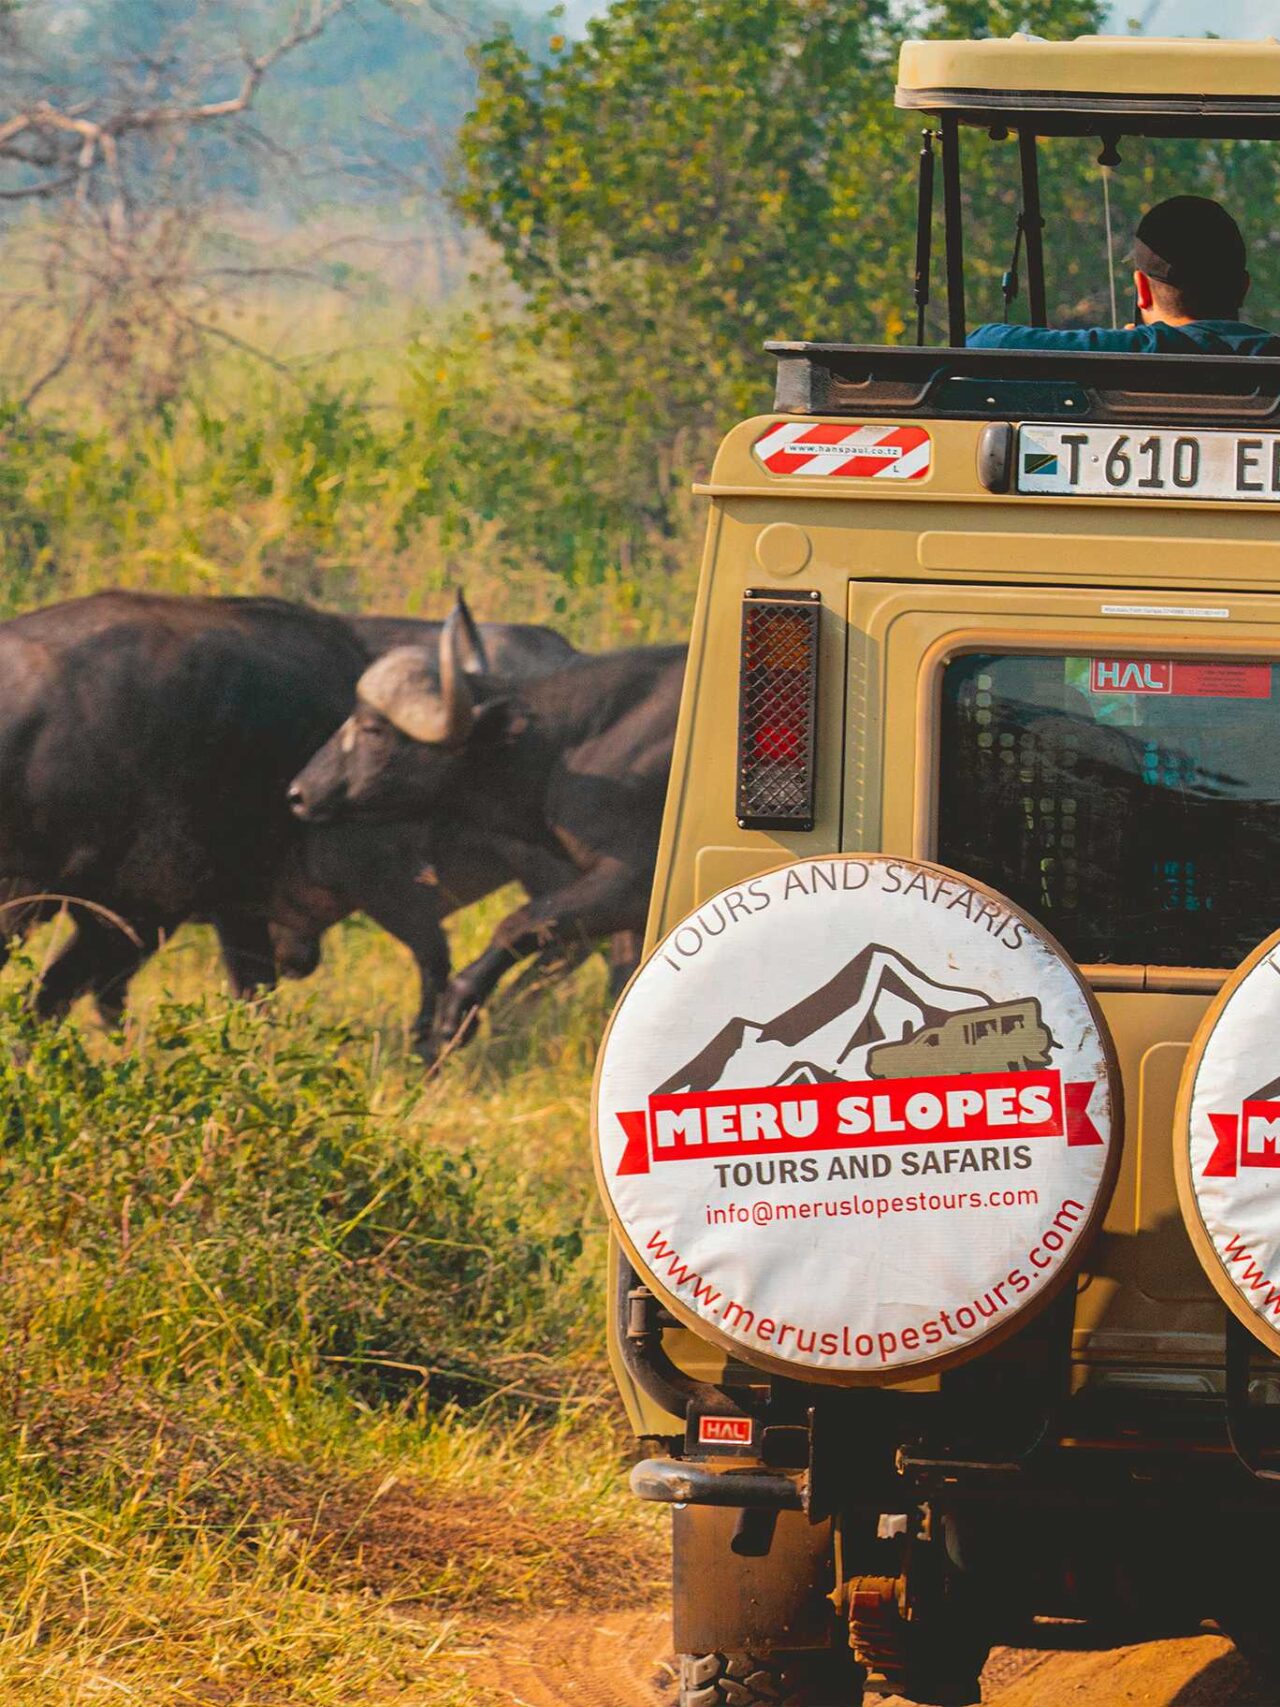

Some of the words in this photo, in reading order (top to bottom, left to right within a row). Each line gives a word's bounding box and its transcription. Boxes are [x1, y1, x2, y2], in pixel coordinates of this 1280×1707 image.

[789, 444, 898, 456] www.hanspaul.co.tz
[893, 464, 900, 474] L
[1060, 433, 1089, 485] T
[1105, 434, 1200, 489] 610
[1097, 662, 1164, 688] HAL
[653, 878, 772, 974] TOURS
[782, 861, 871, 901] AND
[880, 861, 1028, 954] SAFARIS
[653, 1098, 820, 1149] MERU
[835, 1084, 1057, 1135] SLOPES
[713, 1157, 820, 1189] TOURS
[826, 1150, 893, 1181] AND
[900, 1143, 1034, 1177] SAFARIS
[705, 1186, 1040, 1227] info@meruslopestours.com
[645, 1198, 1085, 1363] www.meruslopestours.com
[706, 1422, 746, 1439] HAL
